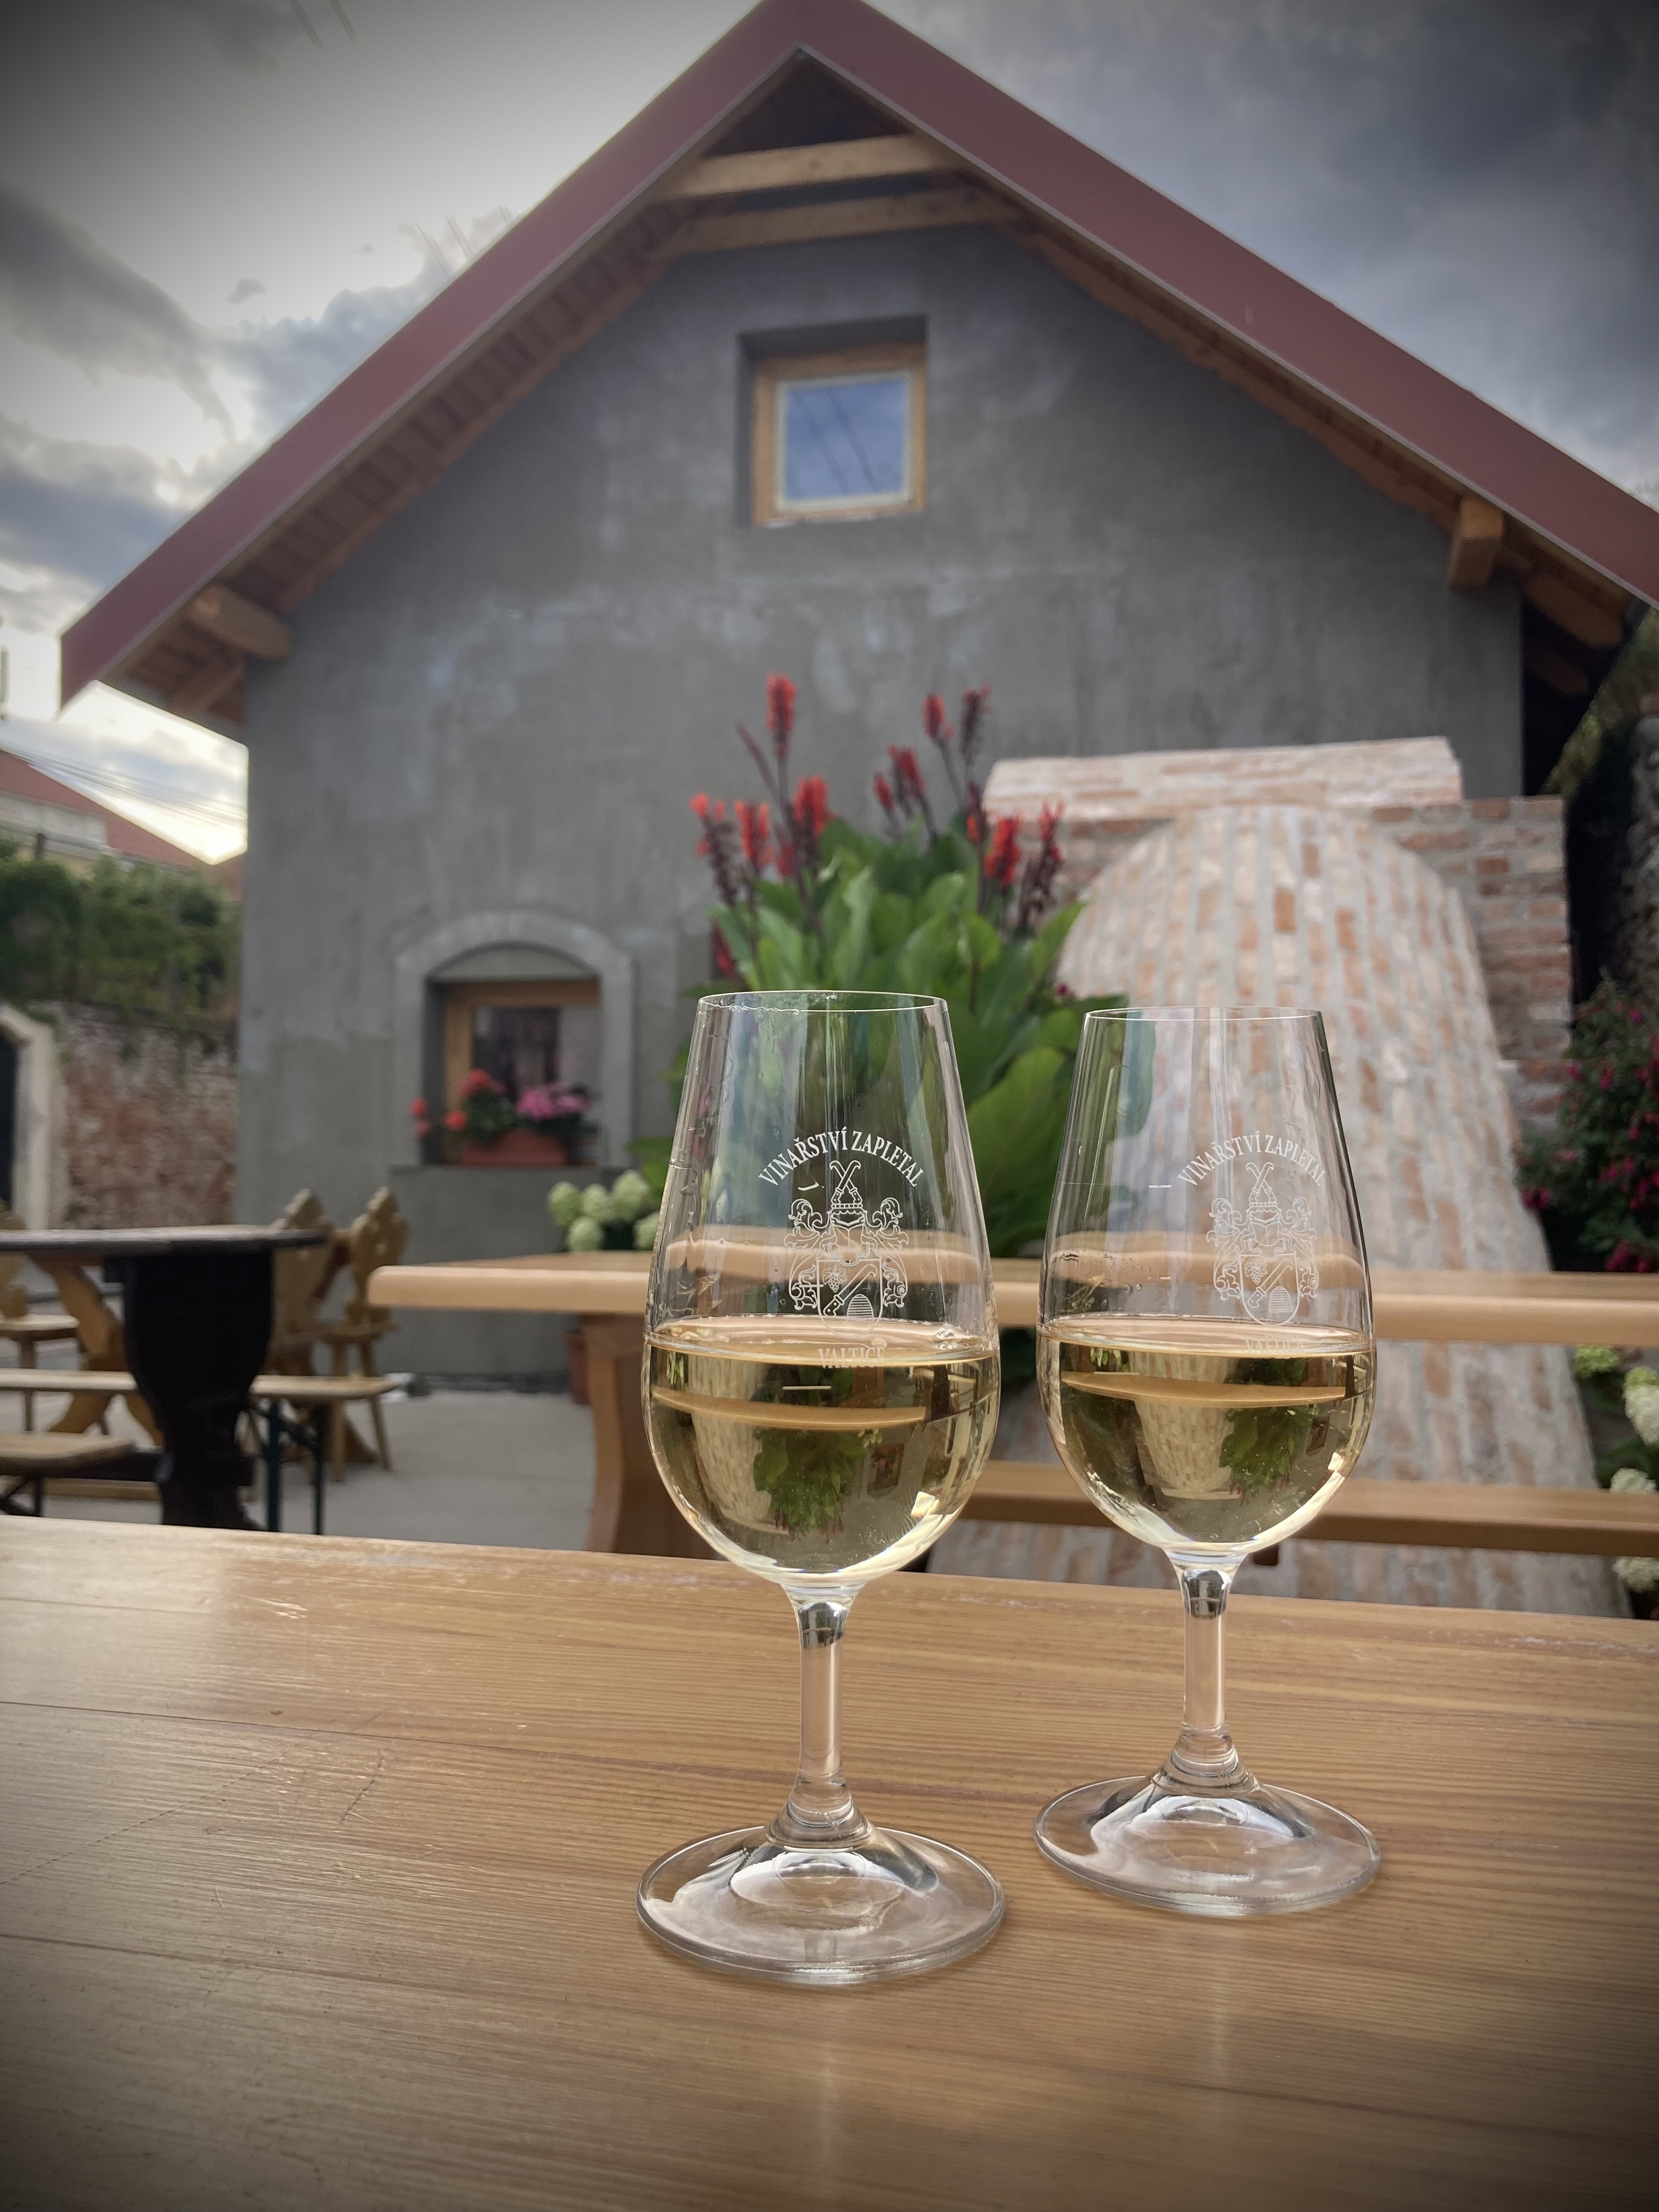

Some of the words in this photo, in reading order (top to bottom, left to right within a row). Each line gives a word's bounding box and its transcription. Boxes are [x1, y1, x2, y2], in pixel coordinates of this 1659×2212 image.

[758, 1126, 848, 1186] VINAŘSTVÍ
[851, 1130, 924, 1187] ZAPLETAL
[1177, 1130, 1262, 1186] VINAŘSTVÍ
[1265, 1135, 1325, 1186] ZAPLETAL
[818, 1347, 885, 1368] VALTICE
